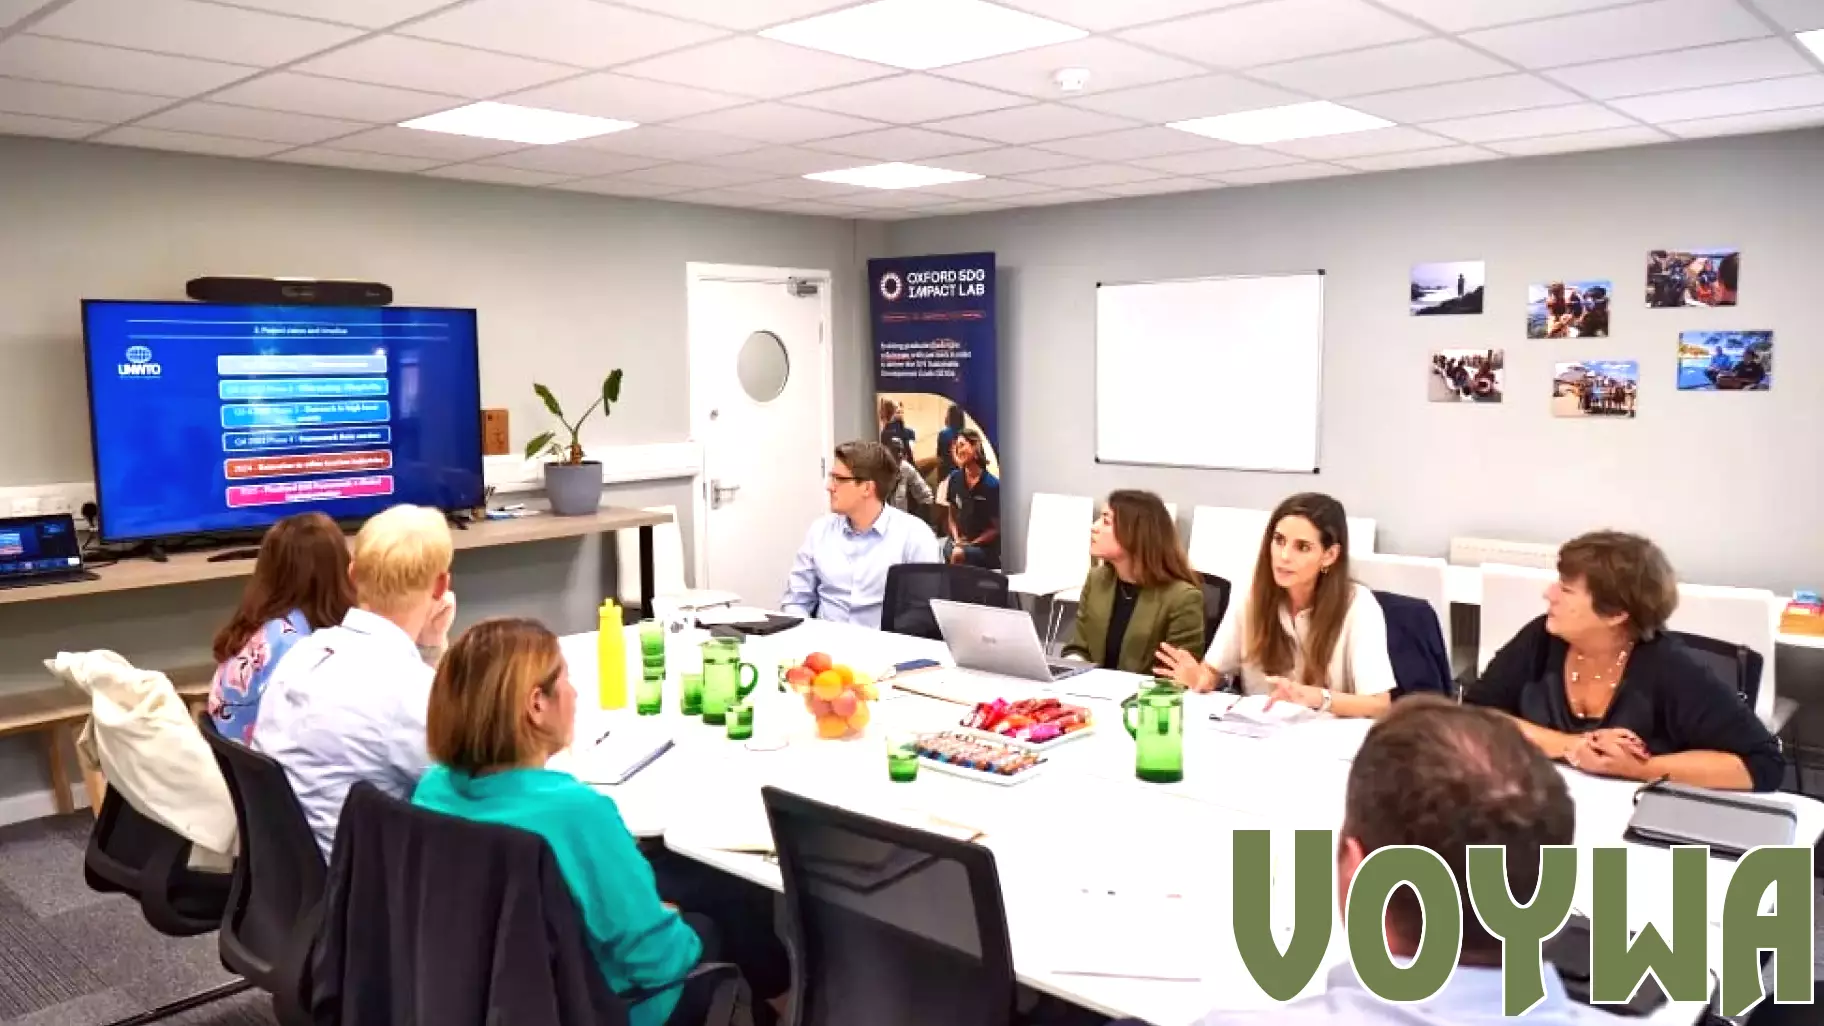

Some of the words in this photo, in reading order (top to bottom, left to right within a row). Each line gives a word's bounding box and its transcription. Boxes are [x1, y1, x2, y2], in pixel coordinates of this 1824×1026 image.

[907, 271, 957, 283] OXFORD
[908, 285, 956, 298] IMPACT
[959, 284, 985, 296] LAB
